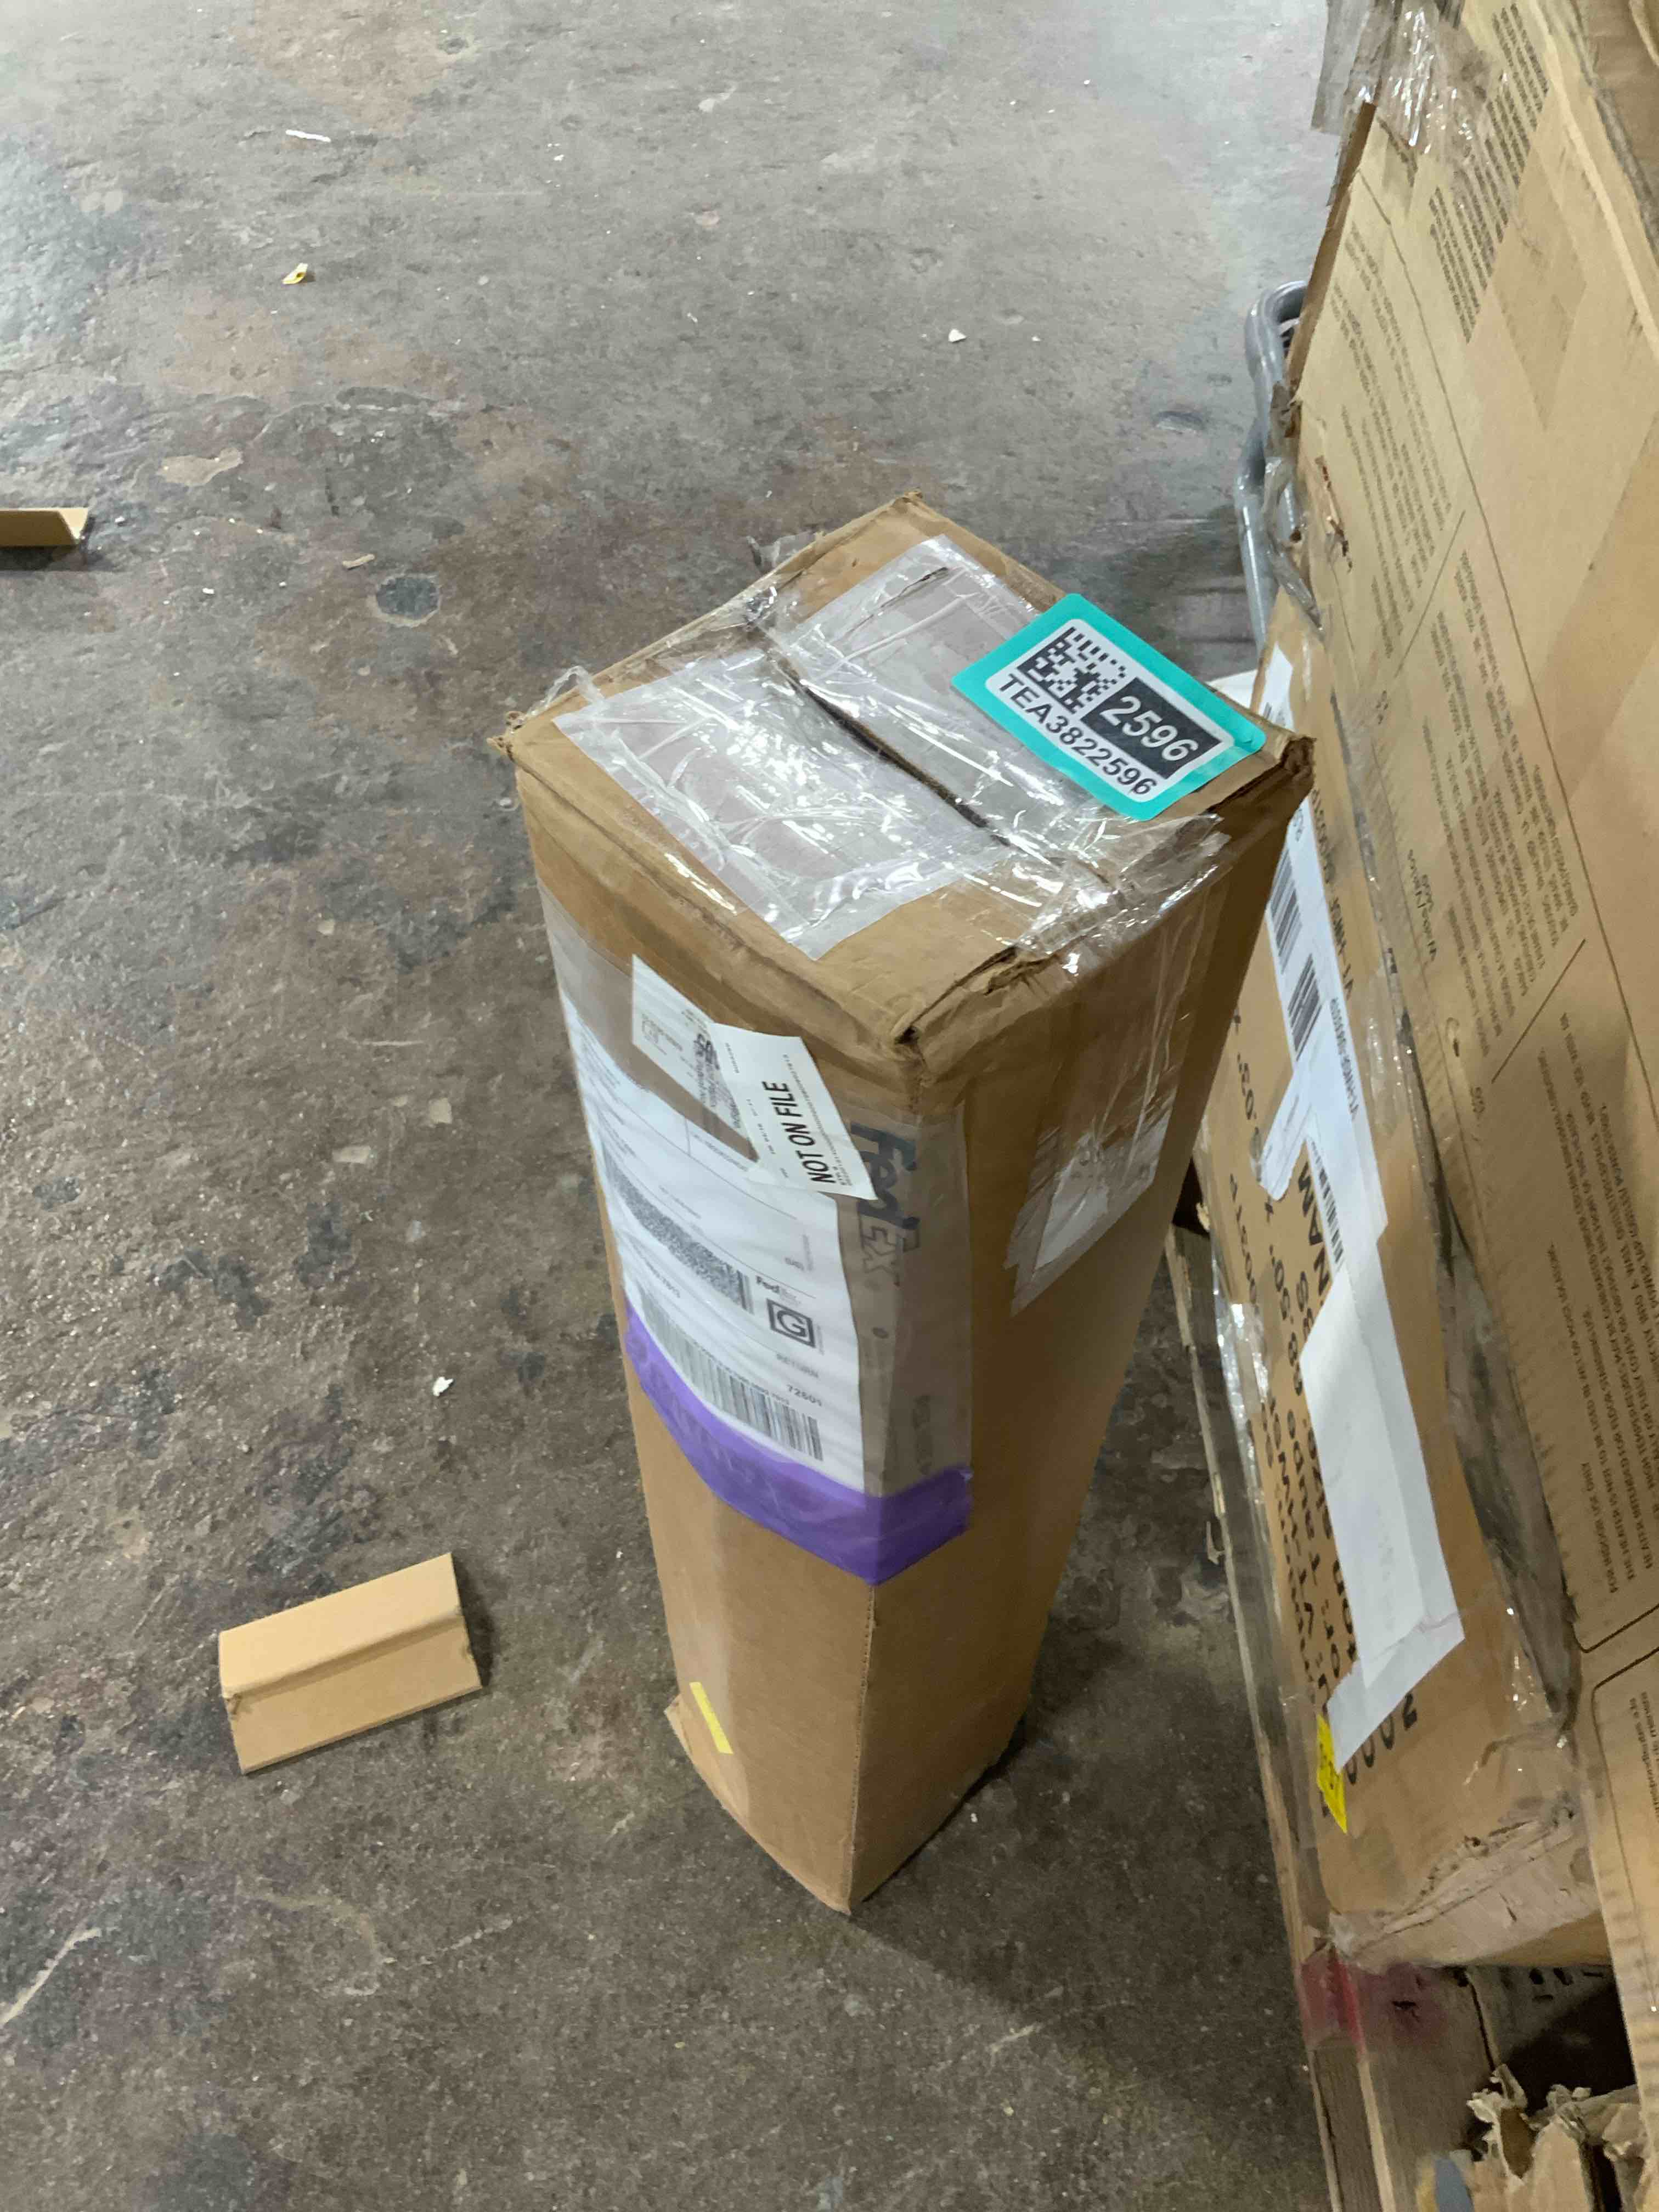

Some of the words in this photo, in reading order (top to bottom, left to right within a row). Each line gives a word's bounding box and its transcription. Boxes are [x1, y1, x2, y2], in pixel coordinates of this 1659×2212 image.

[999, 673, 1157, 795] TEA3822596
[1099, 696, 1199, 761] 2596
[761, 1081, 803, 1118] FILE
[781, 1122, 816, 1147] ON
[795, 1150, 837, 1184] NOT
[776, 1309, 807, 1338] G
[1581, 1462, 1595, 1492] ONLY
[1589, 1494, 1601, 1516] USE
[1594, 1519, 1612, 1566] INDOOR
[1612, 1509, 1629, 1555] HEATER
[1636, 1521, 1654, 1569] HEATER
[1605, 1568, 1619, 1594] FOR
